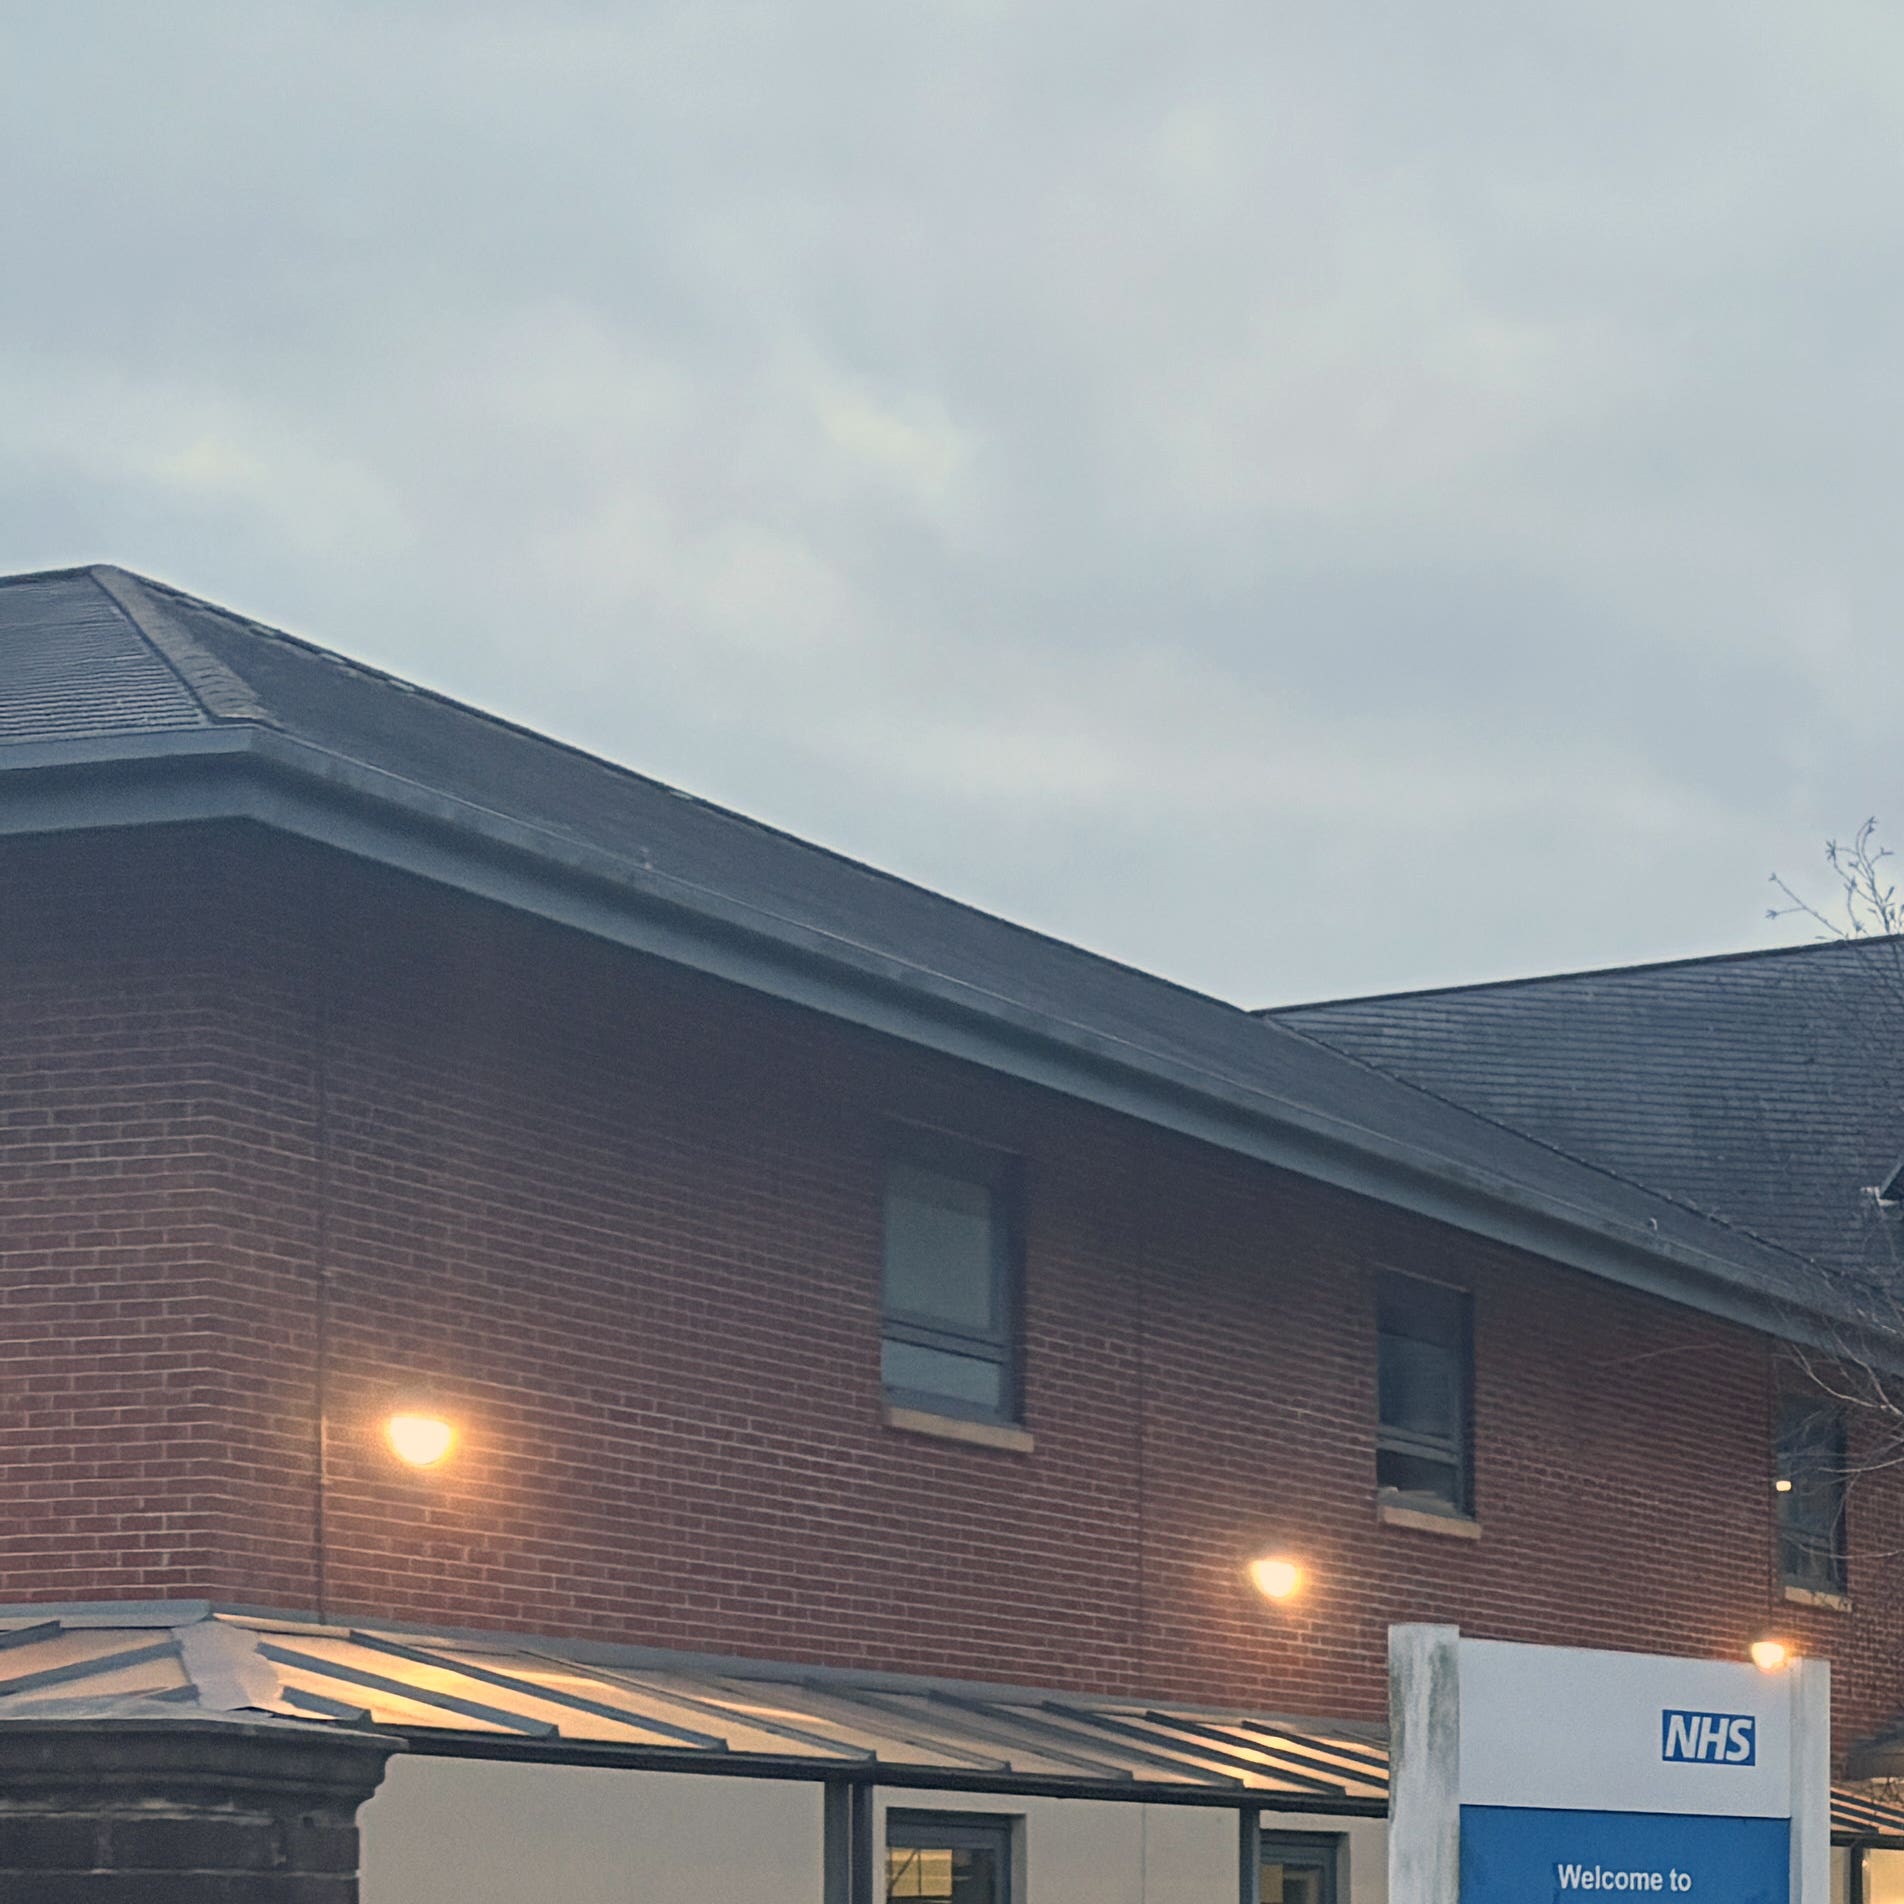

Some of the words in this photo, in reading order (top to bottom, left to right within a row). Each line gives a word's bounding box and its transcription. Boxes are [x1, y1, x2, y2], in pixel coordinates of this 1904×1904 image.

[1664, 1713, 1754, 1763] NHS
[1557, 1864, 1663, 1891] Welcome
[1669, 1868, 1692, 1892] to
